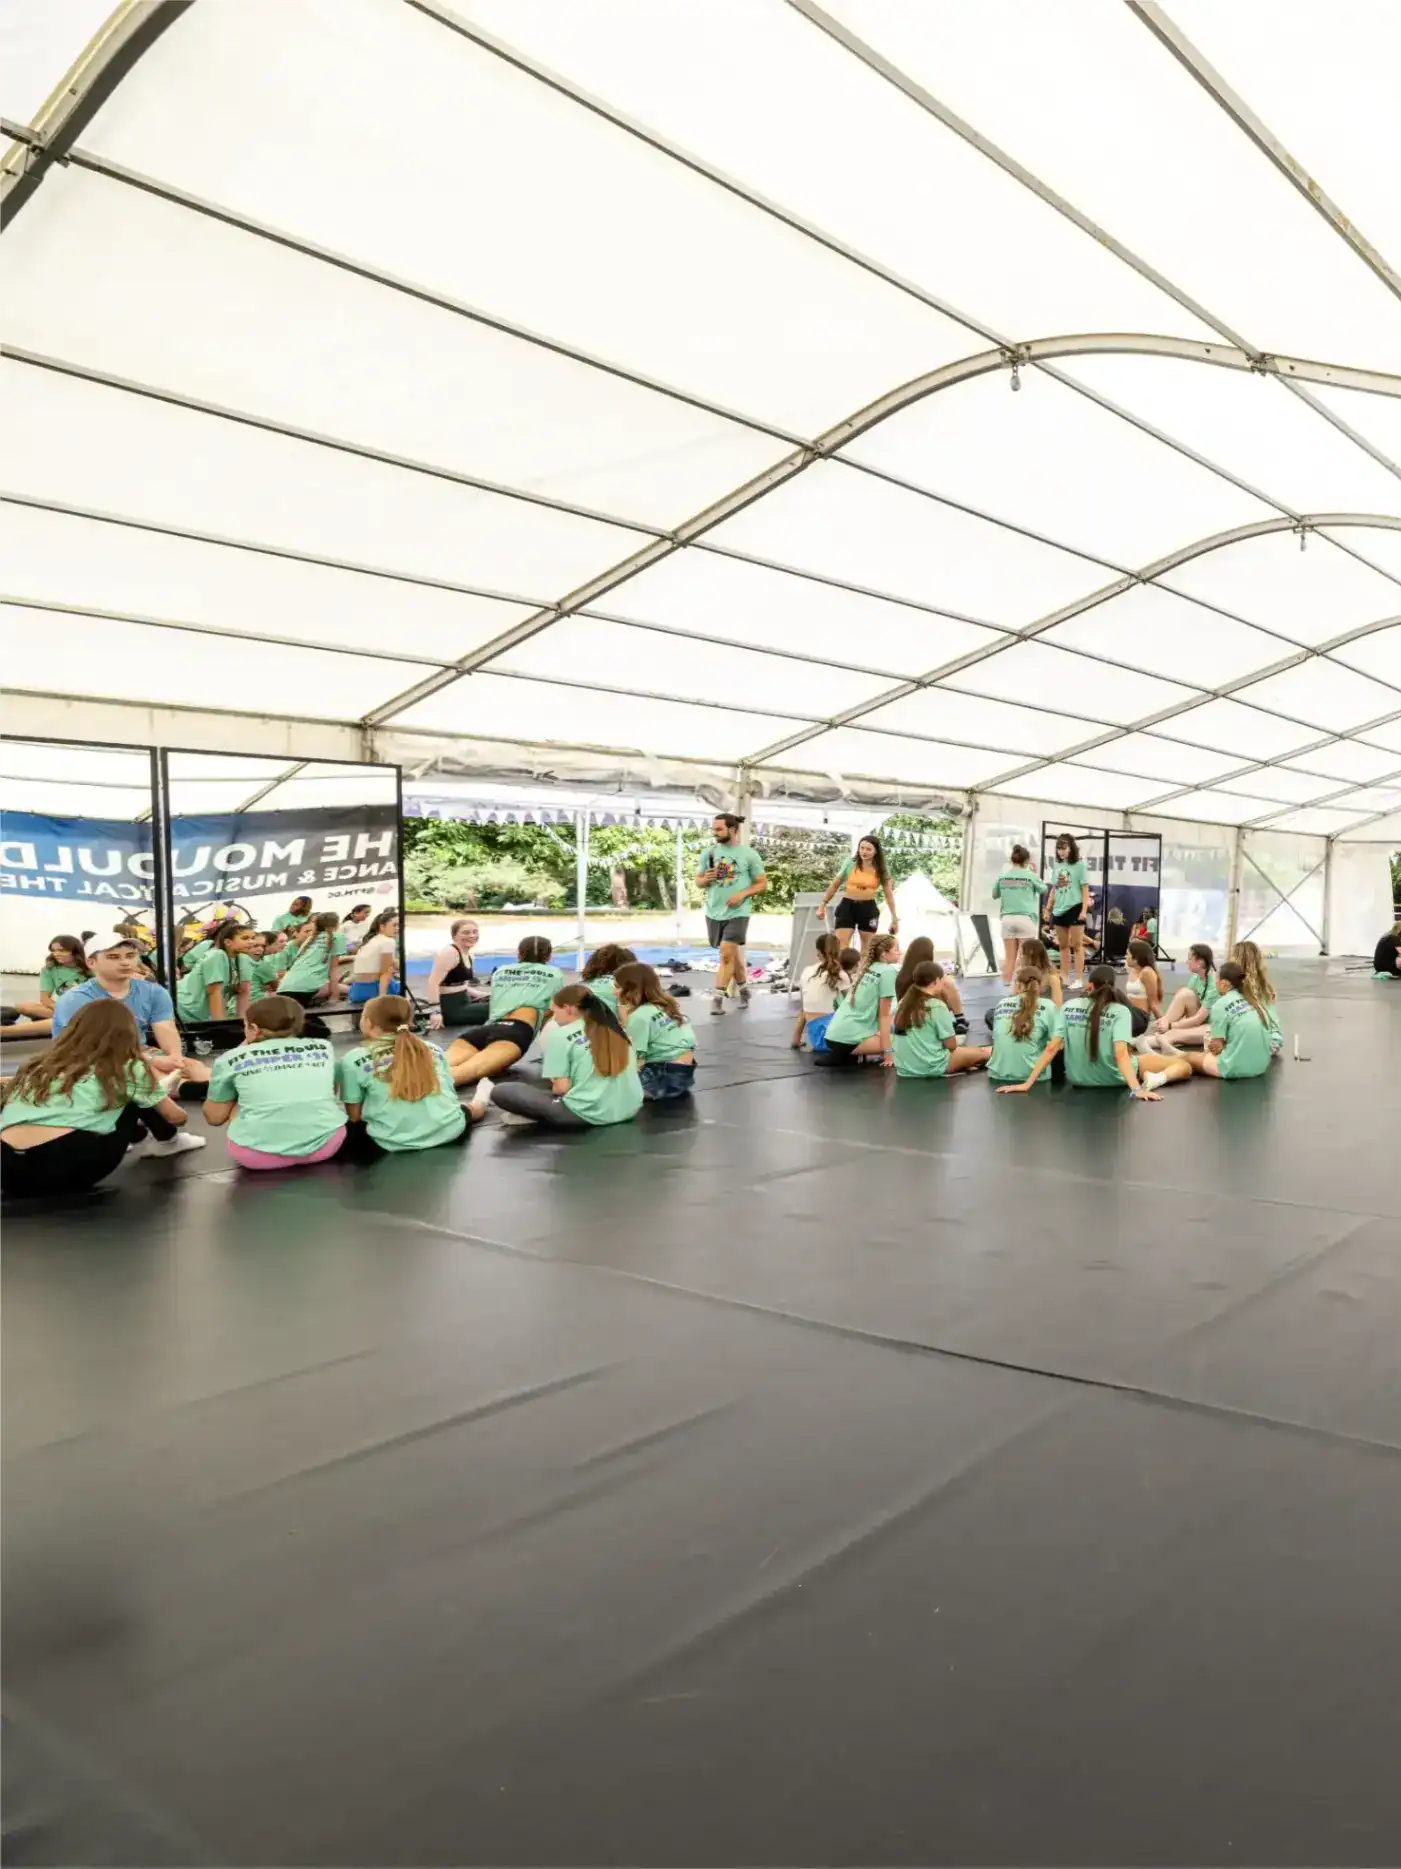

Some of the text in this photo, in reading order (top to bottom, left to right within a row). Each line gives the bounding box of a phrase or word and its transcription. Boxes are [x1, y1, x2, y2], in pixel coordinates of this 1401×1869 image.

[227, 1043, 327, 1067] FIT THE MOULD
